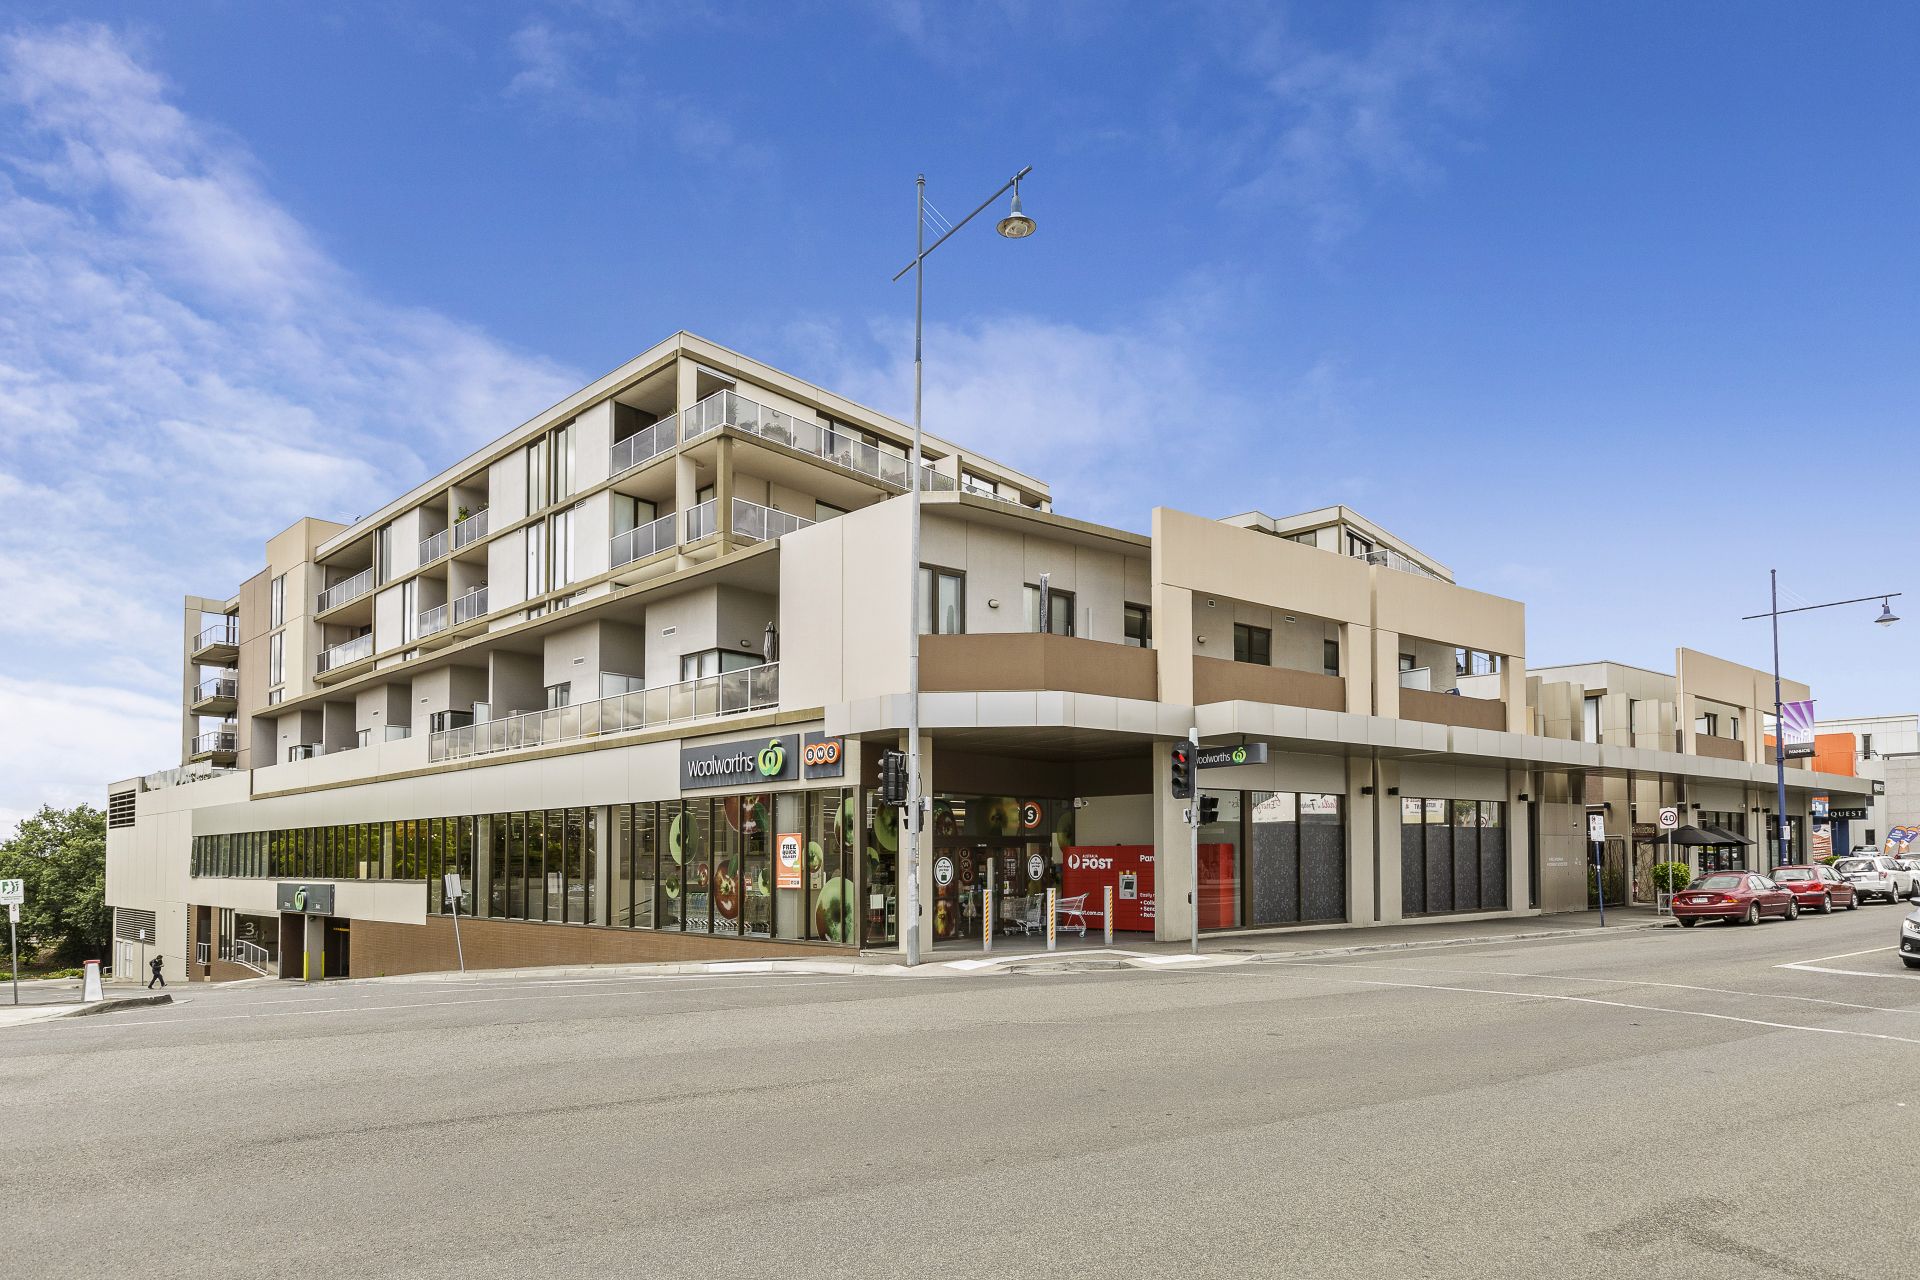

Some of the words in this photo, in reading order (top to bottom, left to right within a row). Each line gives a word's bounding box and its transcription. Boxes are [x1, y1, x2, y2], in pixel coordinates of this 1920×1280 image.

[687, 751, 754, 777] woolworths
[1663, 814, 1674, 822] 40
[1830, 810, 1862, 818] QUEST
[1082, 858, 1113, 869] POST
[245, 922, 254, 935] 3
